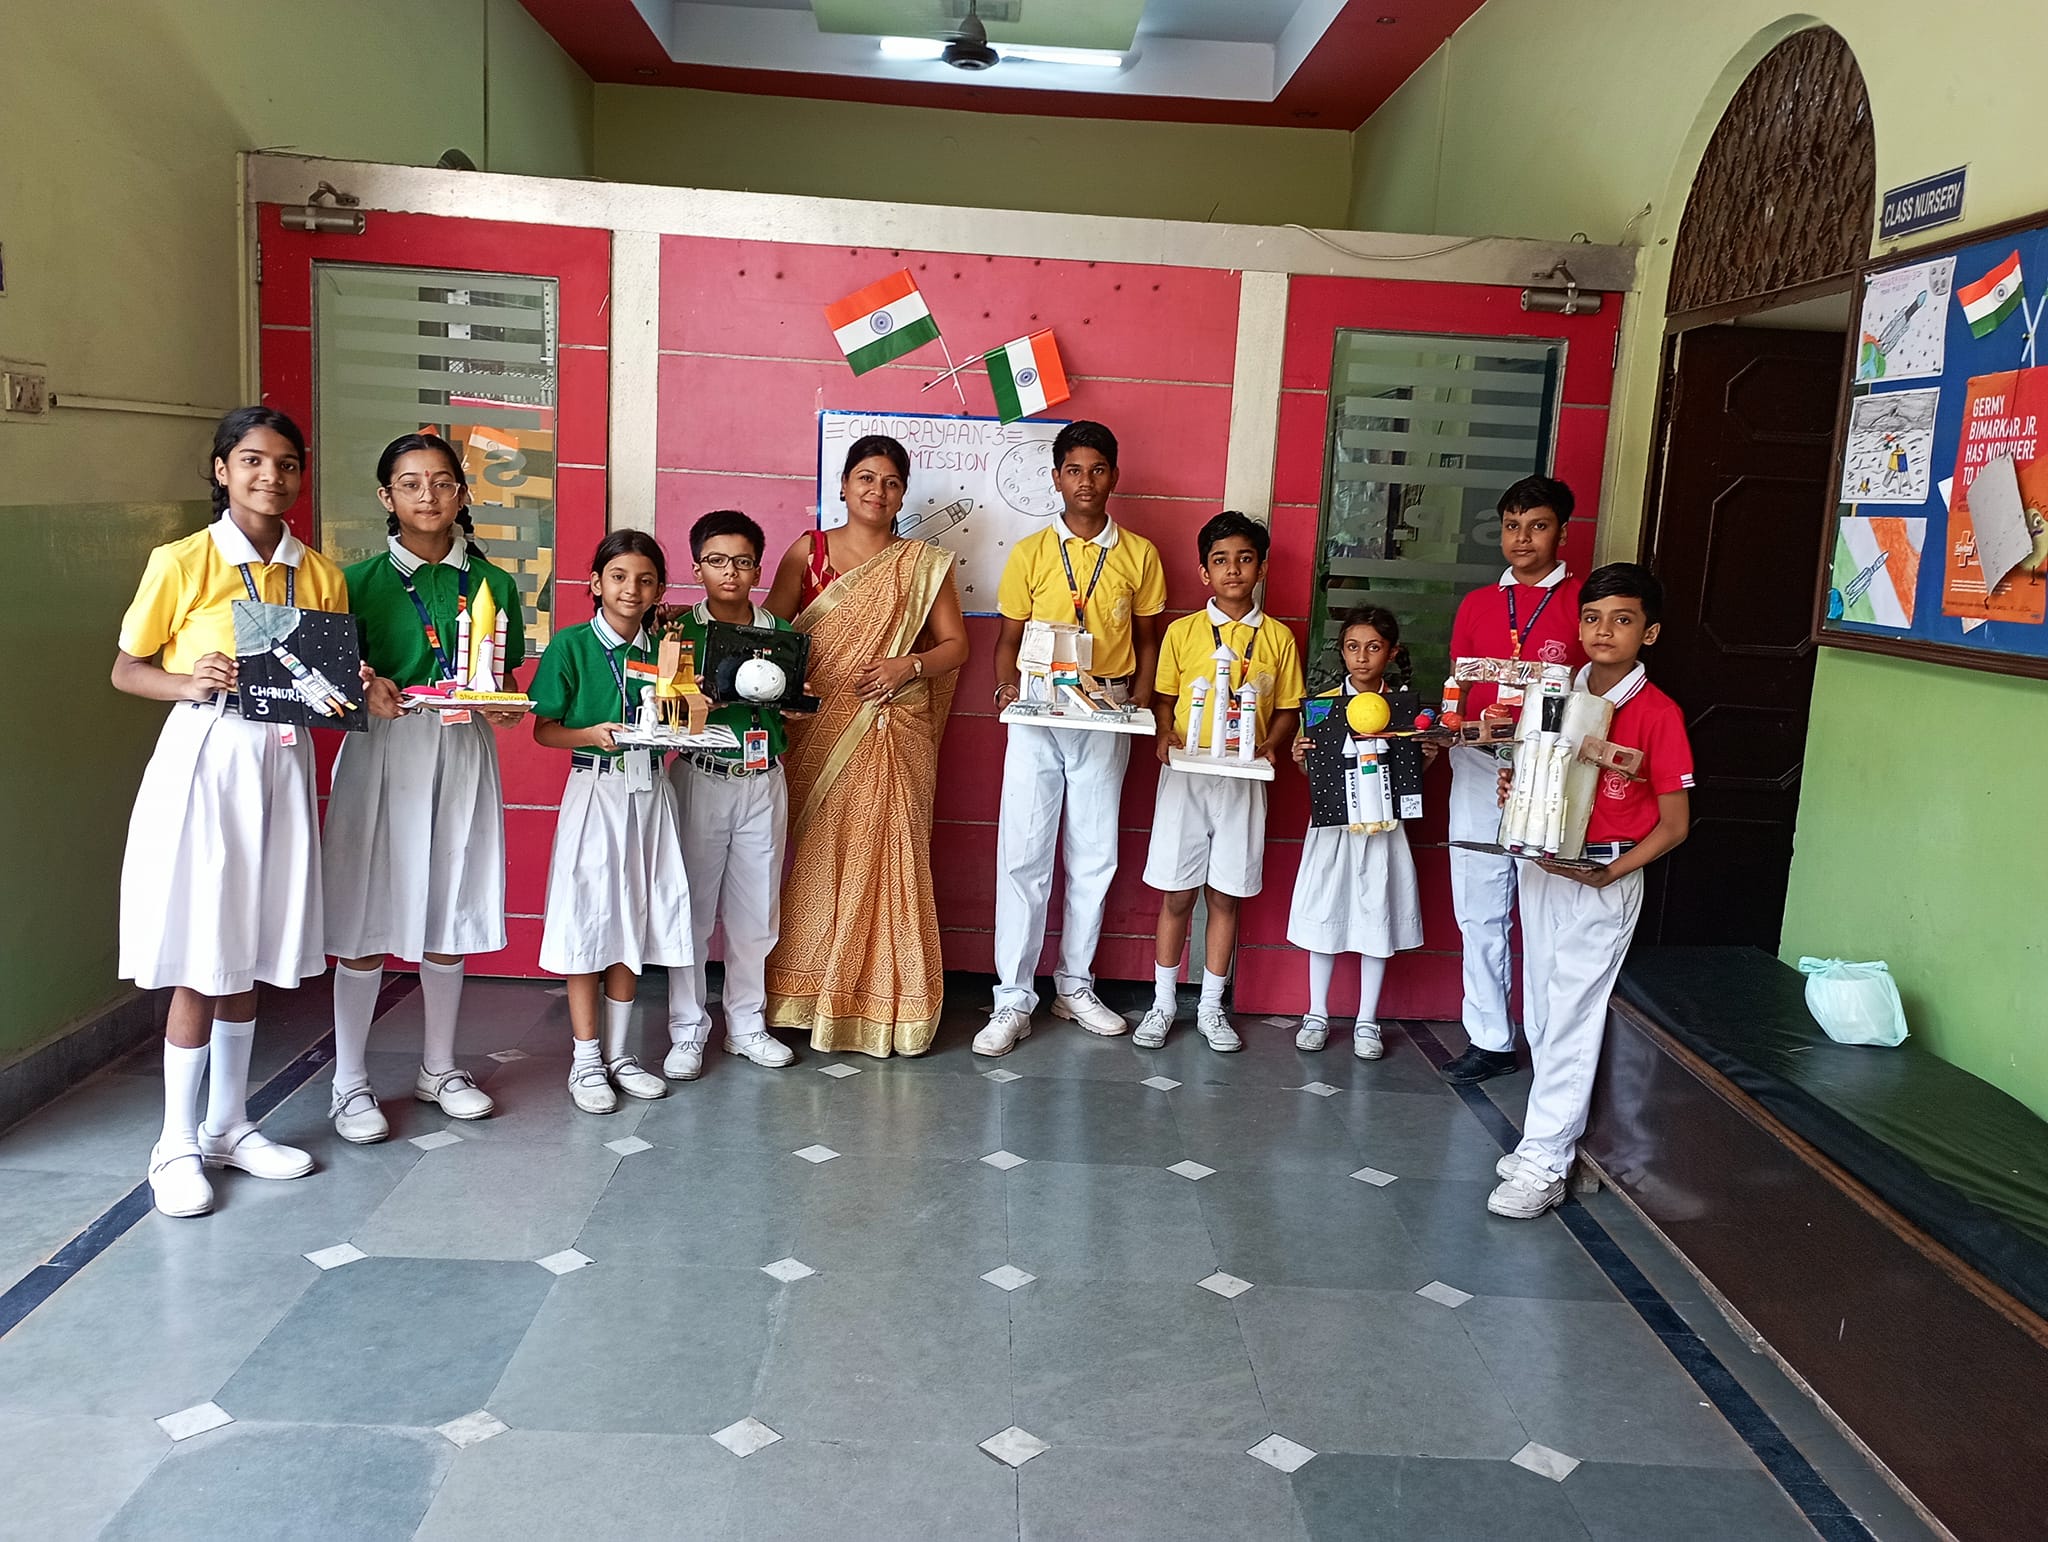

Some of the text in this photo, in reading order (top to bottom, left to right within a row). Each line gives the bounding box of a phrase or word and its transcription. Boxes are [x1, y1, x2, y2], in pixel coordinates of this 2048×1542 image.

[1884, 182, 1962, 228] CLASS NURSERY
[1972, 395, 2005, 418] GERMY
[1969, 415, 2038, 440] BIMARKAR JR.
[908, 449, 990, 472] MISSION
[1965, 443, 1985, 463] HAS
[1962, 467, 1974, 486] TO
[255, 698, 270, 715] 3
[1348, 772, 1358, 809] ISRO
[1382, 766, 1391, 800] ISRO
